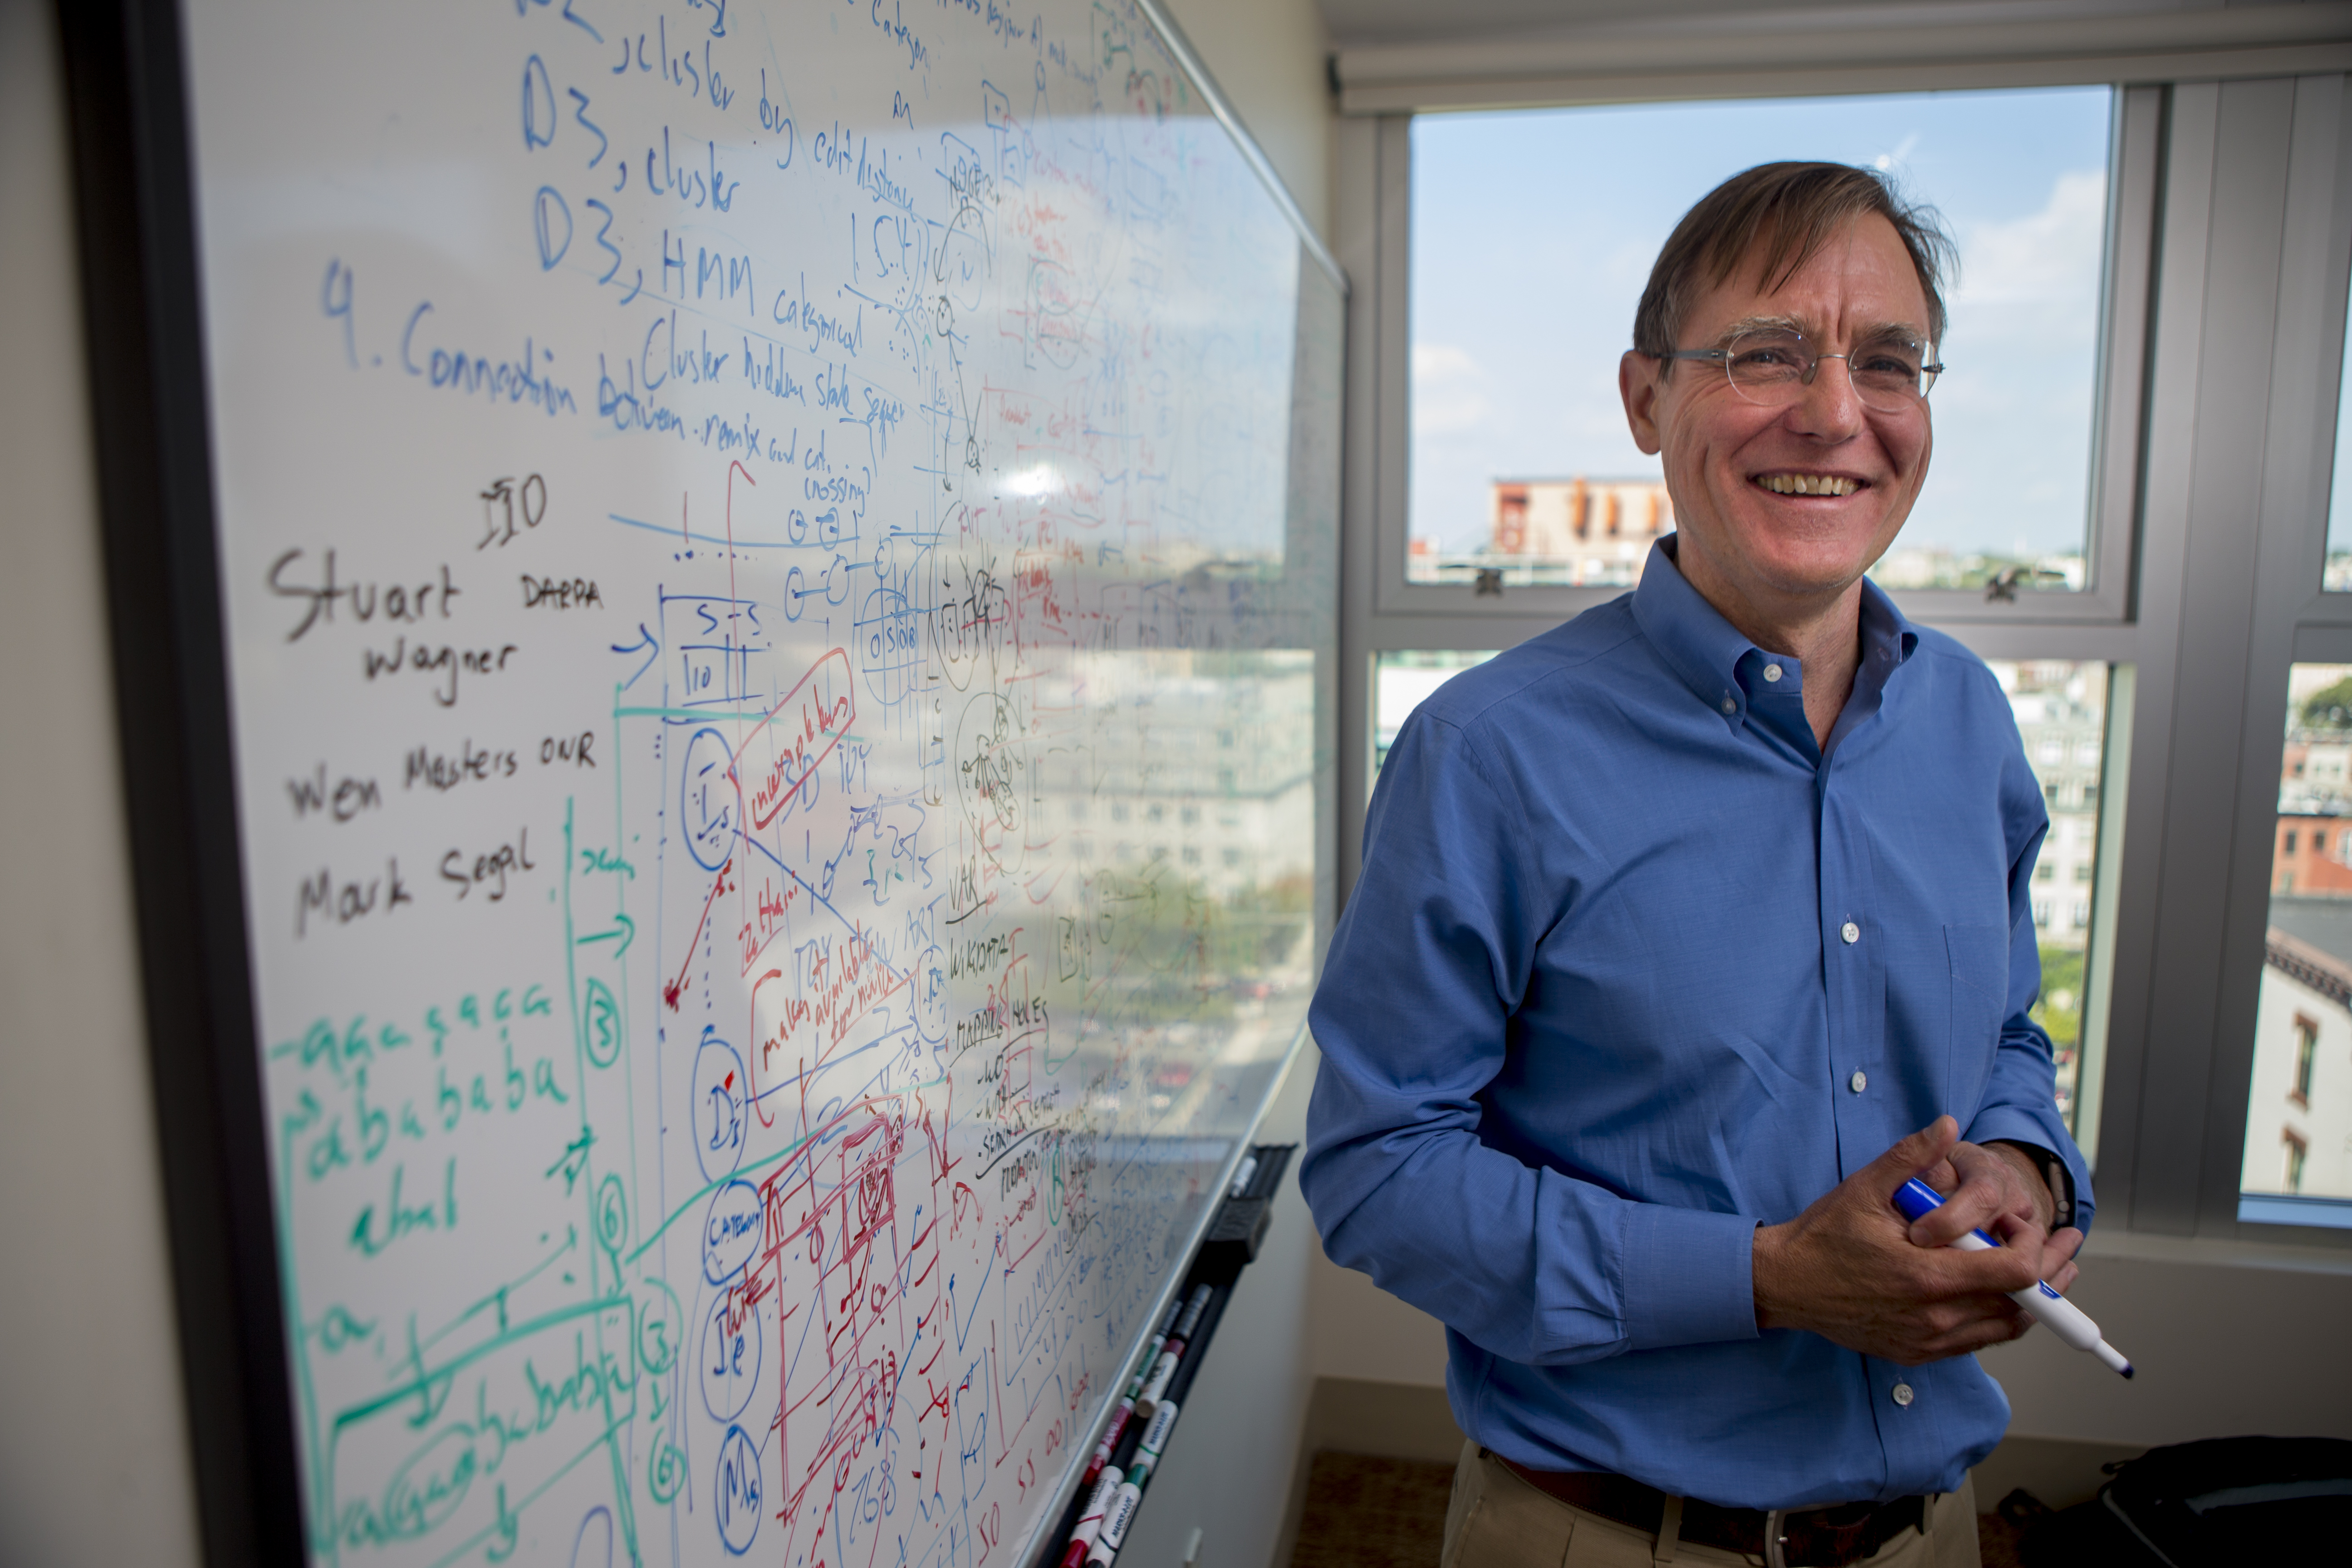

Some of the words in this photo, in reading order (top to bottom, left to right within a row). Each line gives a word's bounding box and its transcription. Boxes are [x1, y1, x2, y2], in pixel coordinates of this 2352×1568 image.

[662, 228, 756, 318] HMM
[267, 548, 462, 643] Stuart
[364, 635, 519, 708] Wagner
[404, 739, 518, 792] Masters
[540, 730, 597, 768] ONR
[294, 857, 412, 939] Mark
